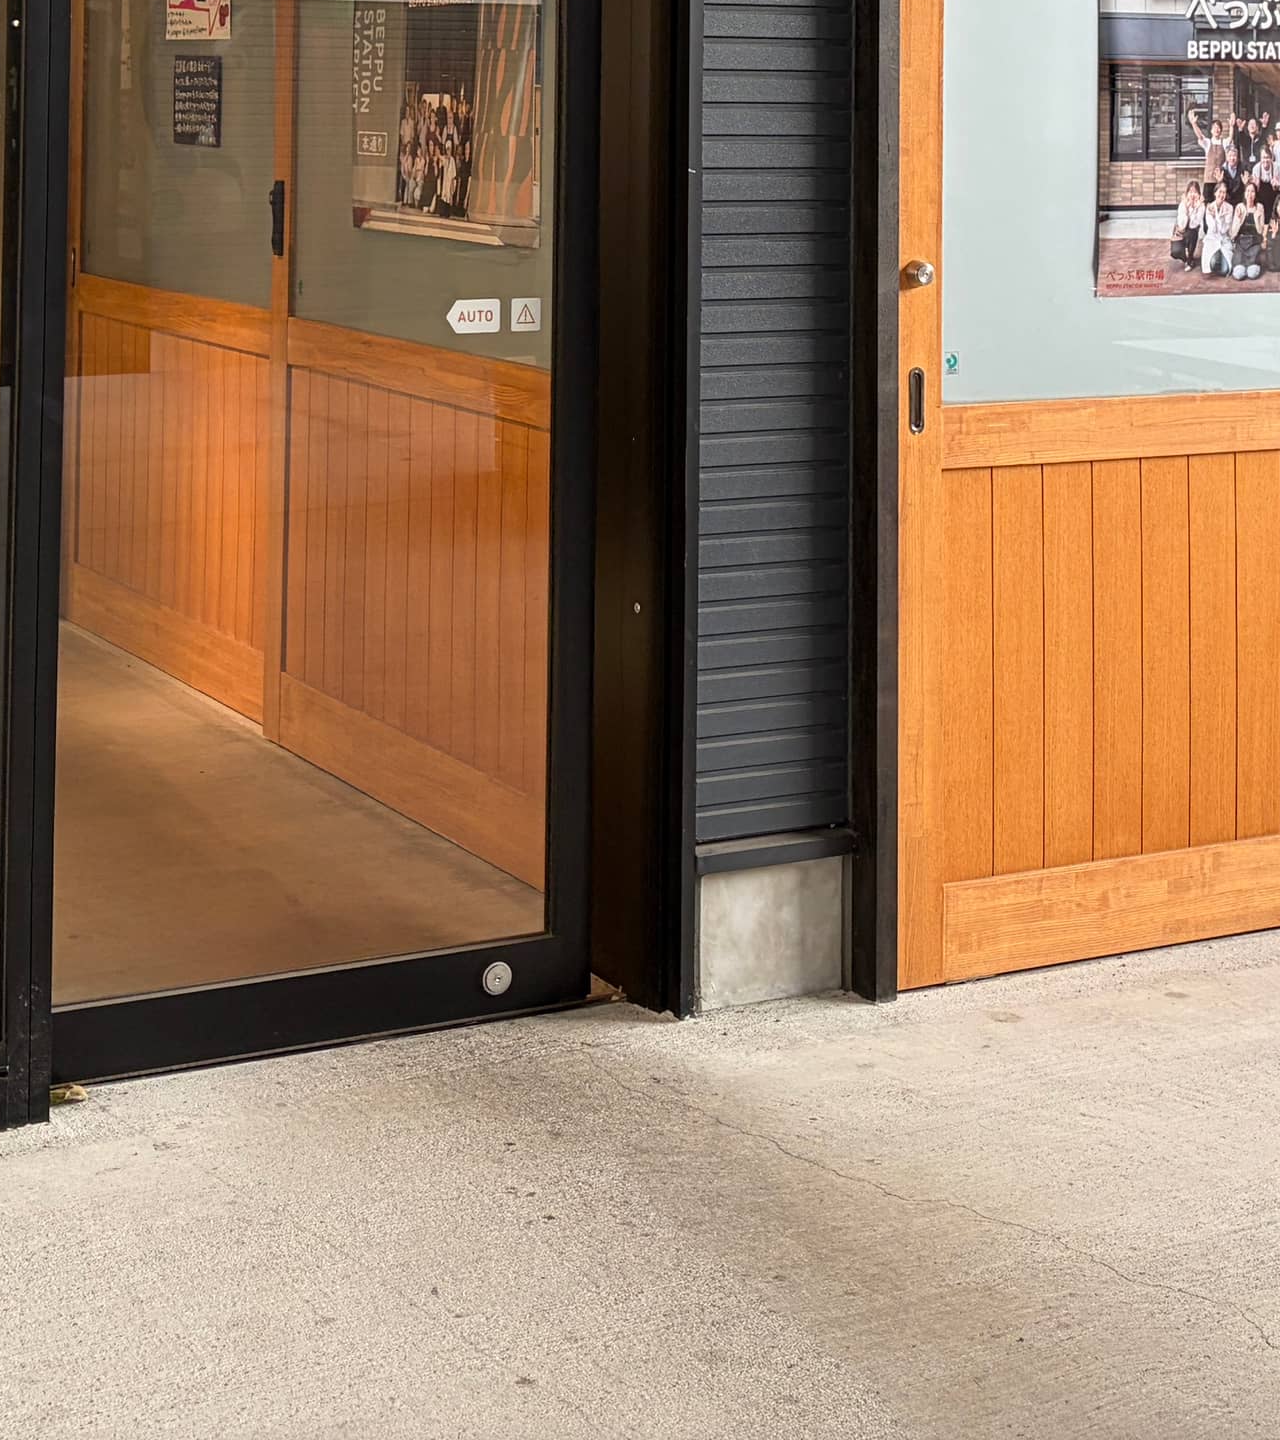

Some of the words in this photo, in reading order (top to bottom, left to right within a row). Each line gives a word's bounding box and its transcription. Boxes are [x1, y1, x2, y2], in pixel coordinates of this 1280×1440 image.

[360, 10, 374, 113] STATION
[373, 9, 386, 92] BEPPU
[1187, 40, 1242, 59] BEPPU
[457, 310, 494, 322] AUTO
